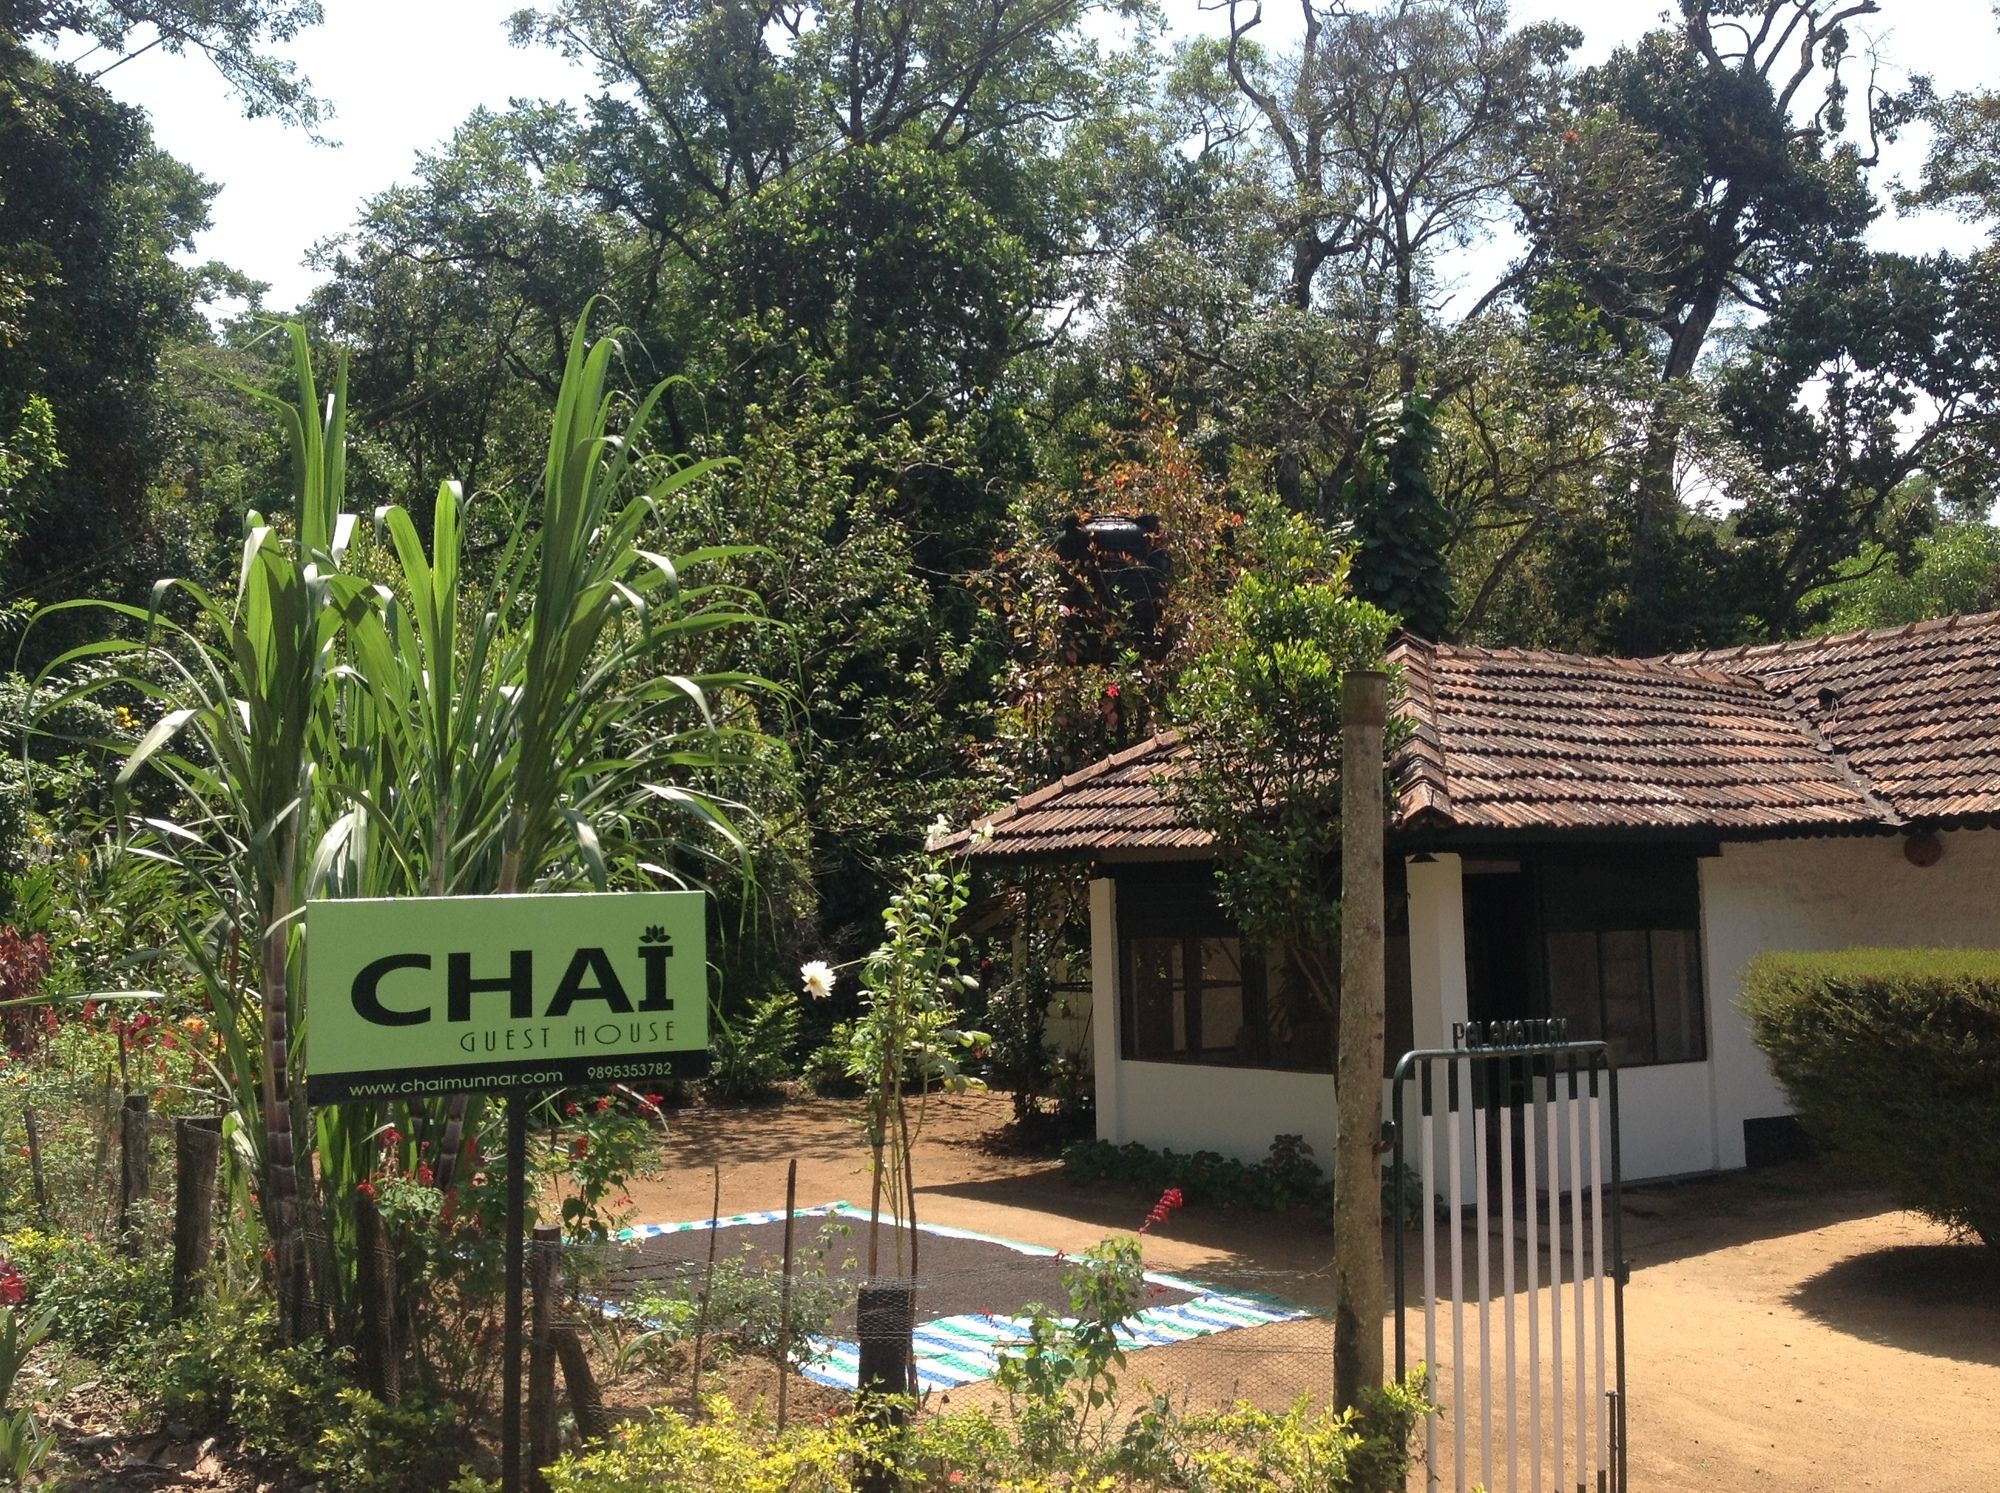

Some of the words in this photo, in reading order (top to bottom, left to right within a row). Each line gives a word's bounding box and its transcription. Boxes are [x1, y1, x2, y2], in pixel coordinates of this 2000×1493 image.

[351, 946, 674, 1026] CHAI
[460, 1027, 550, 1052] GUEST
[574, 1020, 674, 1046] HOUSE
[349, 1069, 563, 1096] www.chaimunnar.com
[586, 1062, 672, 1079] 9895353782
